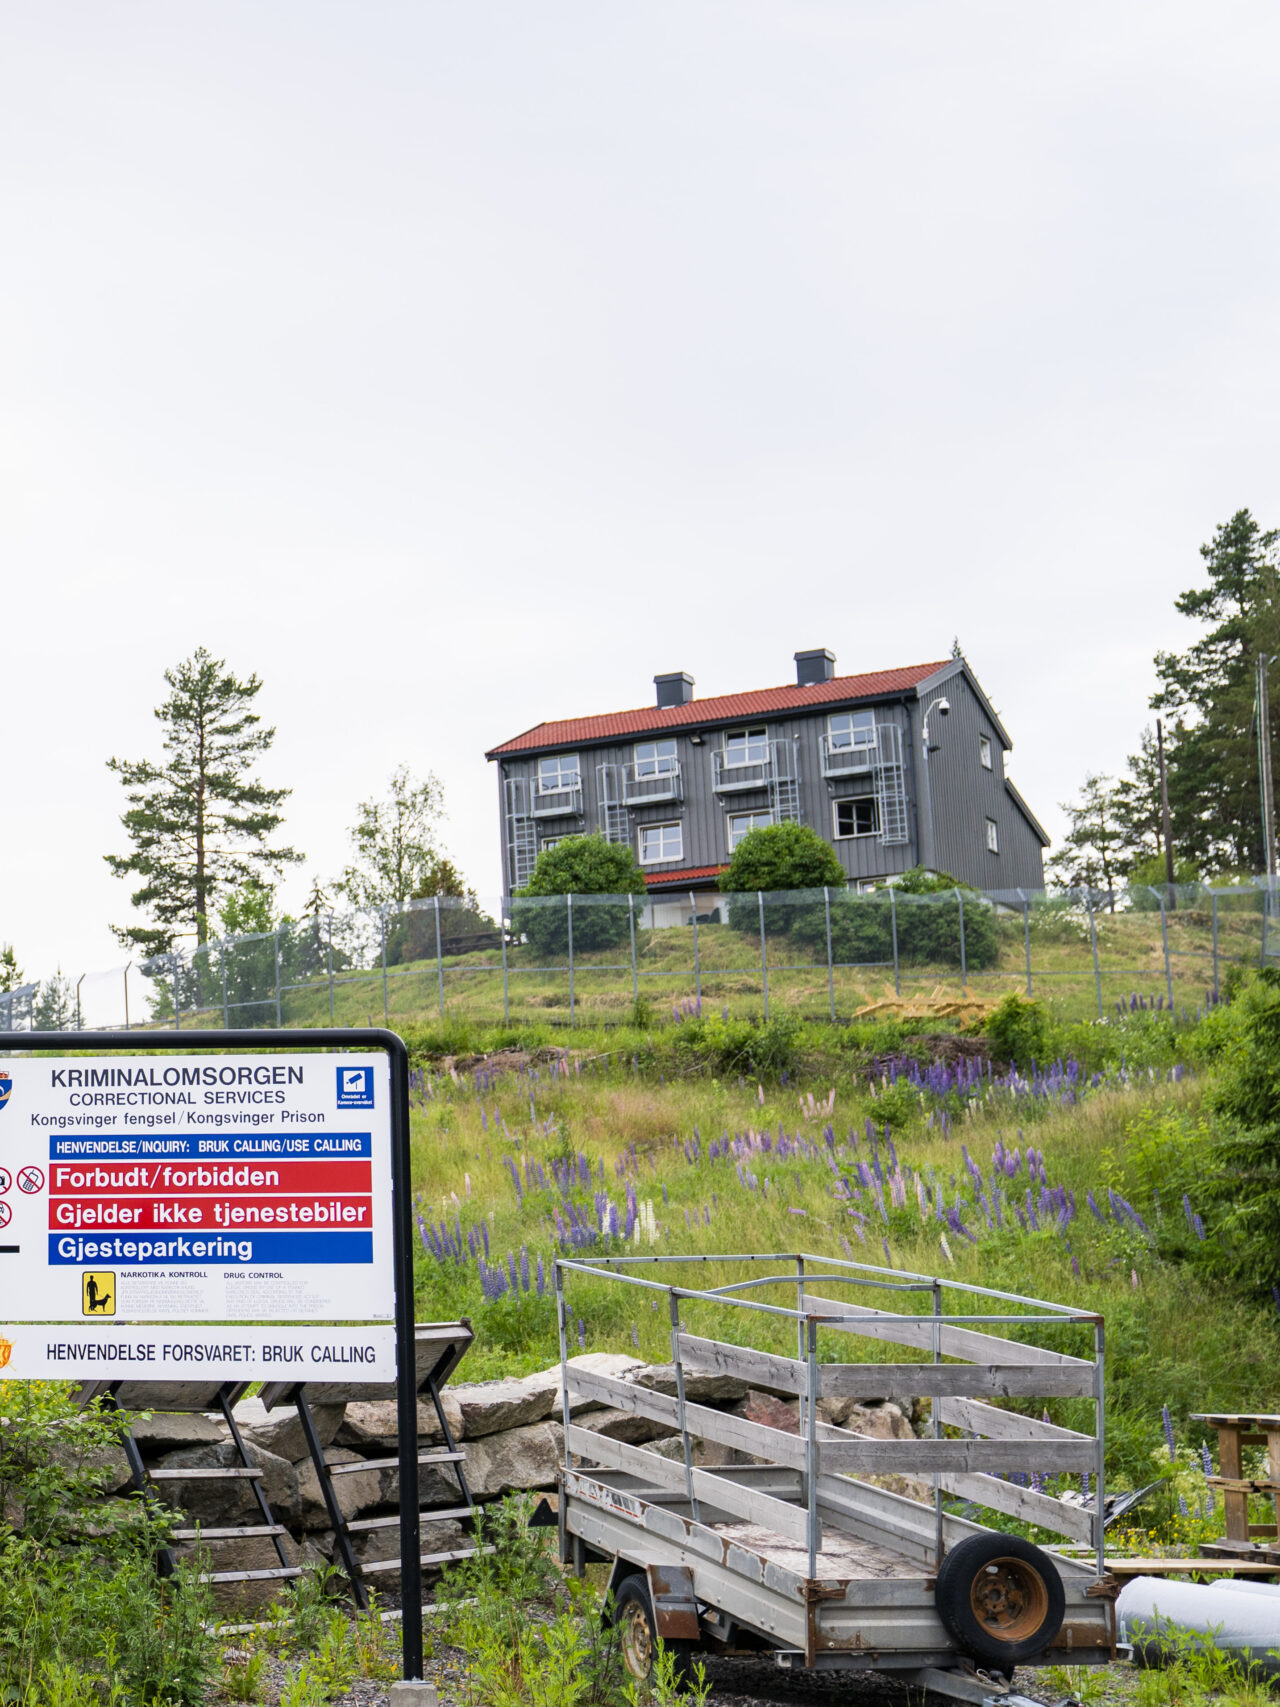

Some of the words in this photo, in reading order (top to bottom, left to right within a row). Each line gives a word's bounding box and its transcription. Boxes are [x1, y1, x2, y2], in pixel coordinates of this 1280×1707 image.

[51, 1066, 304, 1088] KRIMINALOMSORGEN
[69, 1092, 197, 1106] CORRECTIONAL
[204, 1090, 286, 1104] SERVICES
[31, 1113, 118, 1128] Kongsvinger
[281, 1110, 325, 1123] Prison
[198, 1140, 230, 1152] BRUK
[313, 1139, 362, 1151] CALLING
[56, 1203, 143, 1227] Gjelder
[153, 1203, 203, 1223] ikke
[213, 1201, 367, 1227] tjenestebiler
[57, 1236, 253, 1261] Gjesteparkering
[46, 1343, 156, 1361] HENVENDELSE
[162, 1344, 256, 1362] FORSVARET:
[262, 1345, 304, 1362] BRUK
[311, 1345, 376, 1363] CALLING
